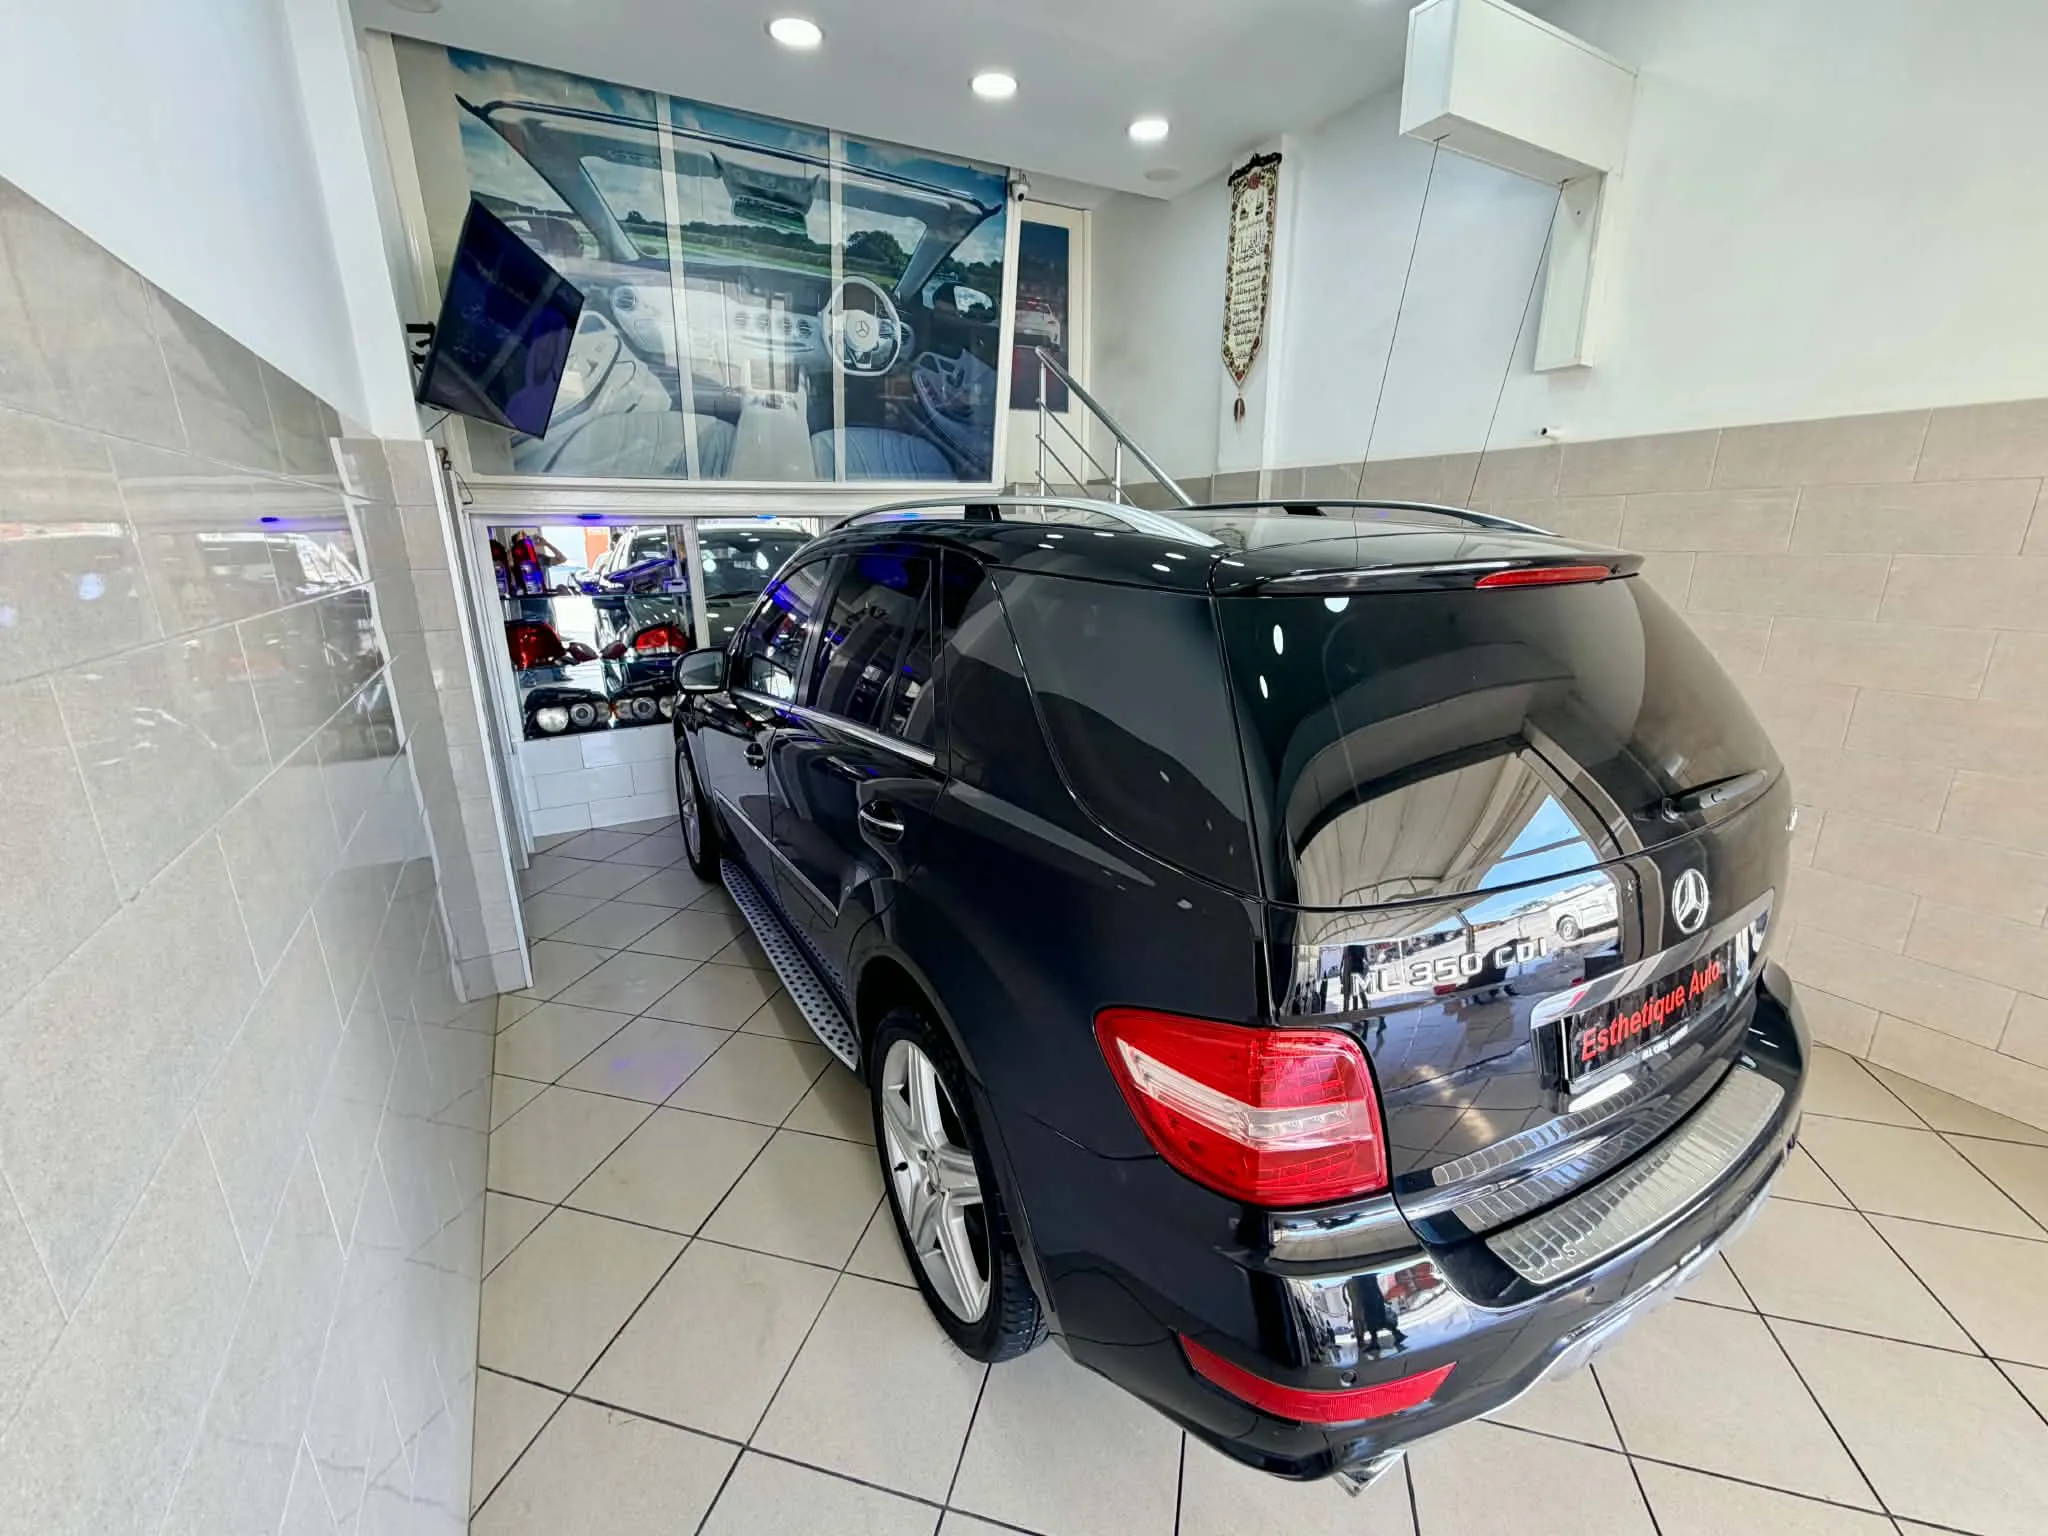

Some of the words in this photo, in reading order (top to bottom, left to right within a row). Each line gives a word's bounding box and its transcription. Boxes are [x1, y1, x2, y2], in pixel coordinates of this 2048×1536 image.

[1350, 965, 1403, 995] ML
[1409, 952, 1482, 986] 350
[1495, 937, 1547, 968] CDI
[1582, 985, 1685, 1062] Esthetique
[1689, 960, 1720, 1001] Auto
